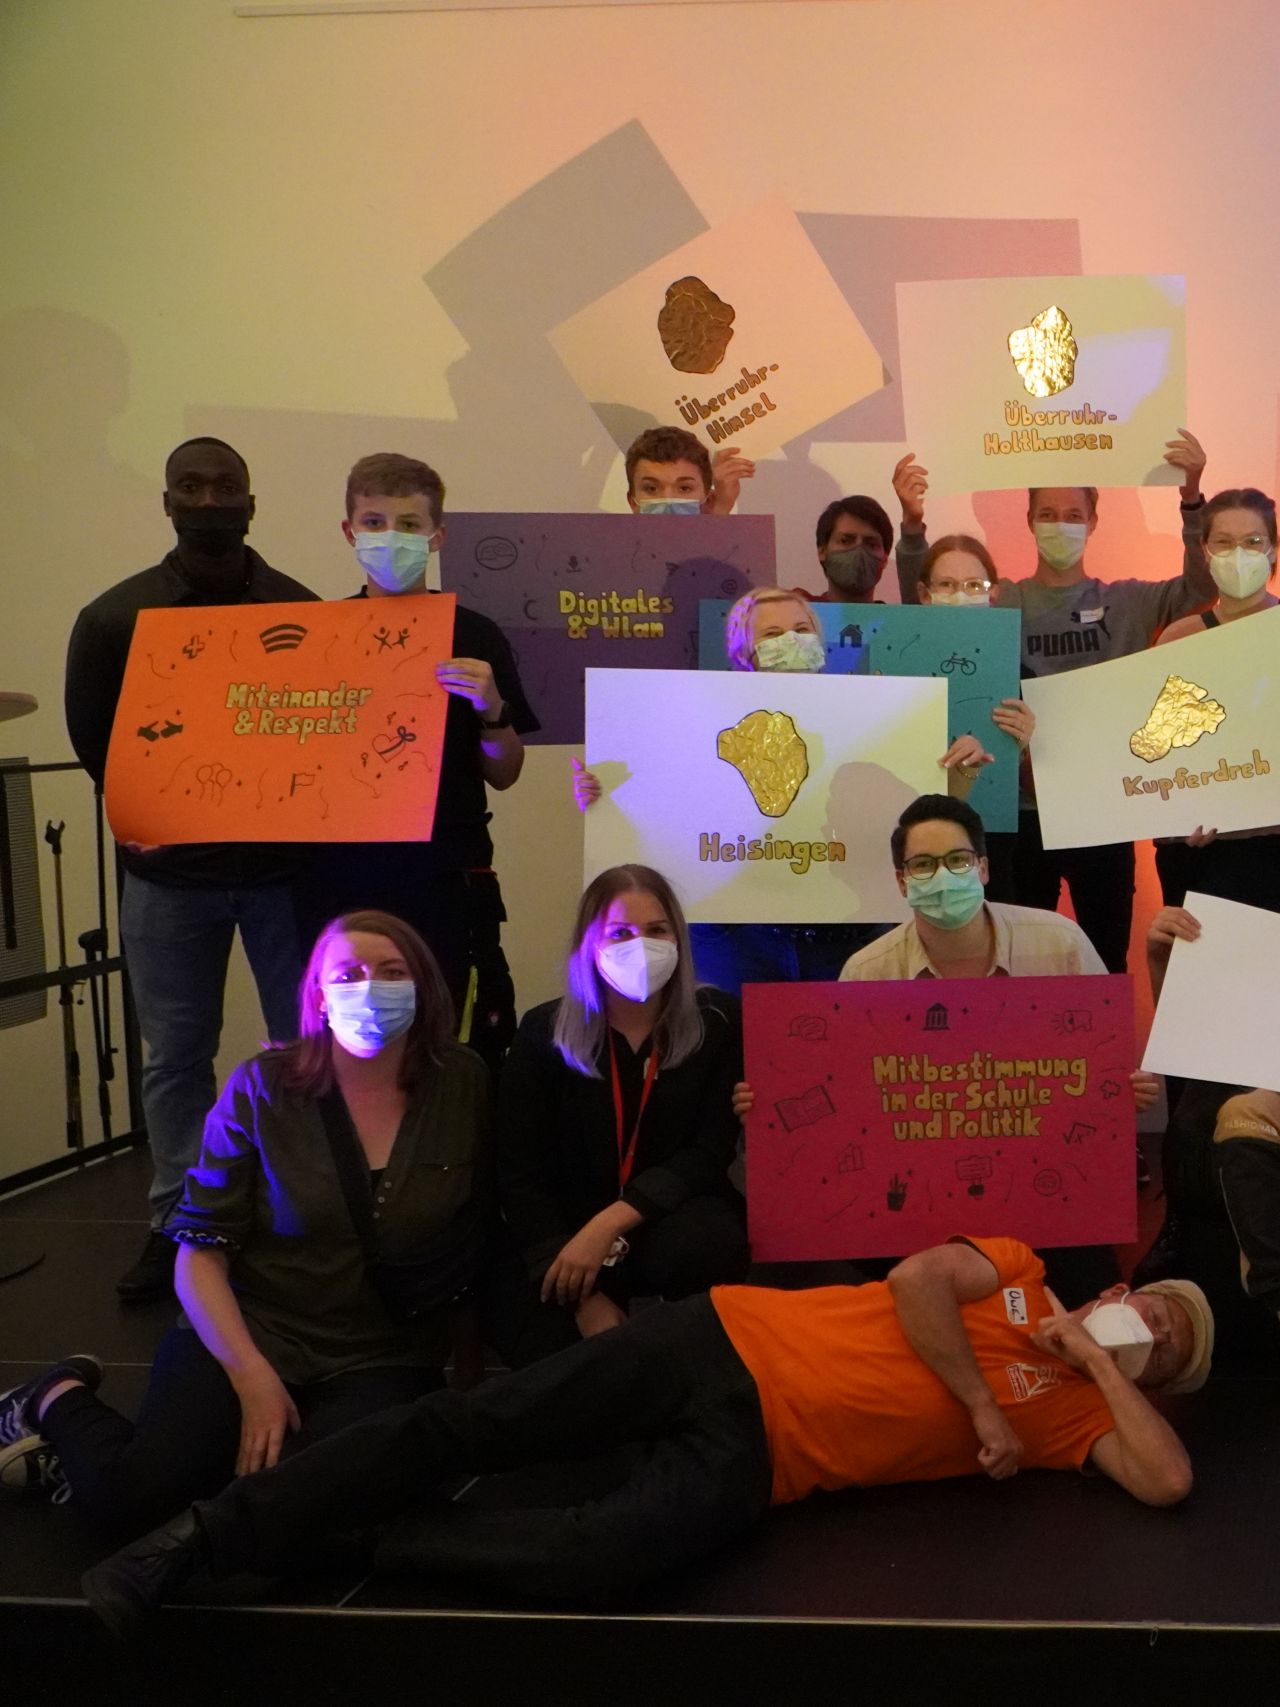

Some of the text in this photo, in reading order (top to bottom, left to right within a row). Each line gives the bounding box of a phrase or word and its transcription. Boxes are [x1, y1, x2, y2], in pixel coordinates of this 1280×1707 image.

[675, 363, 779, 426] Überruhr-
[1004, 400, 1118, 426] Überruhr-
[705, 392, 777, 444] Hinsel
[984, 428, 1113, 455] Holthausen
[559, 588, 674, 626] Digitales
[567, 614, 664, 639] & Wlan
[1026, 628, 1100, 657] PUMA
[225, 681, 373, 709] Miteinander
[233, 706, 358, 745] & Respekt
[1122, 748, 1271, 801] Kupferdreh
[699, 832, 847, 875] Heisingen
[872, 1051, 1088, 1097] Mitbestimmung
[881, 1077, 1053, 1113] in der Schule
[893, 1107, 1043, 1141] und Politik
